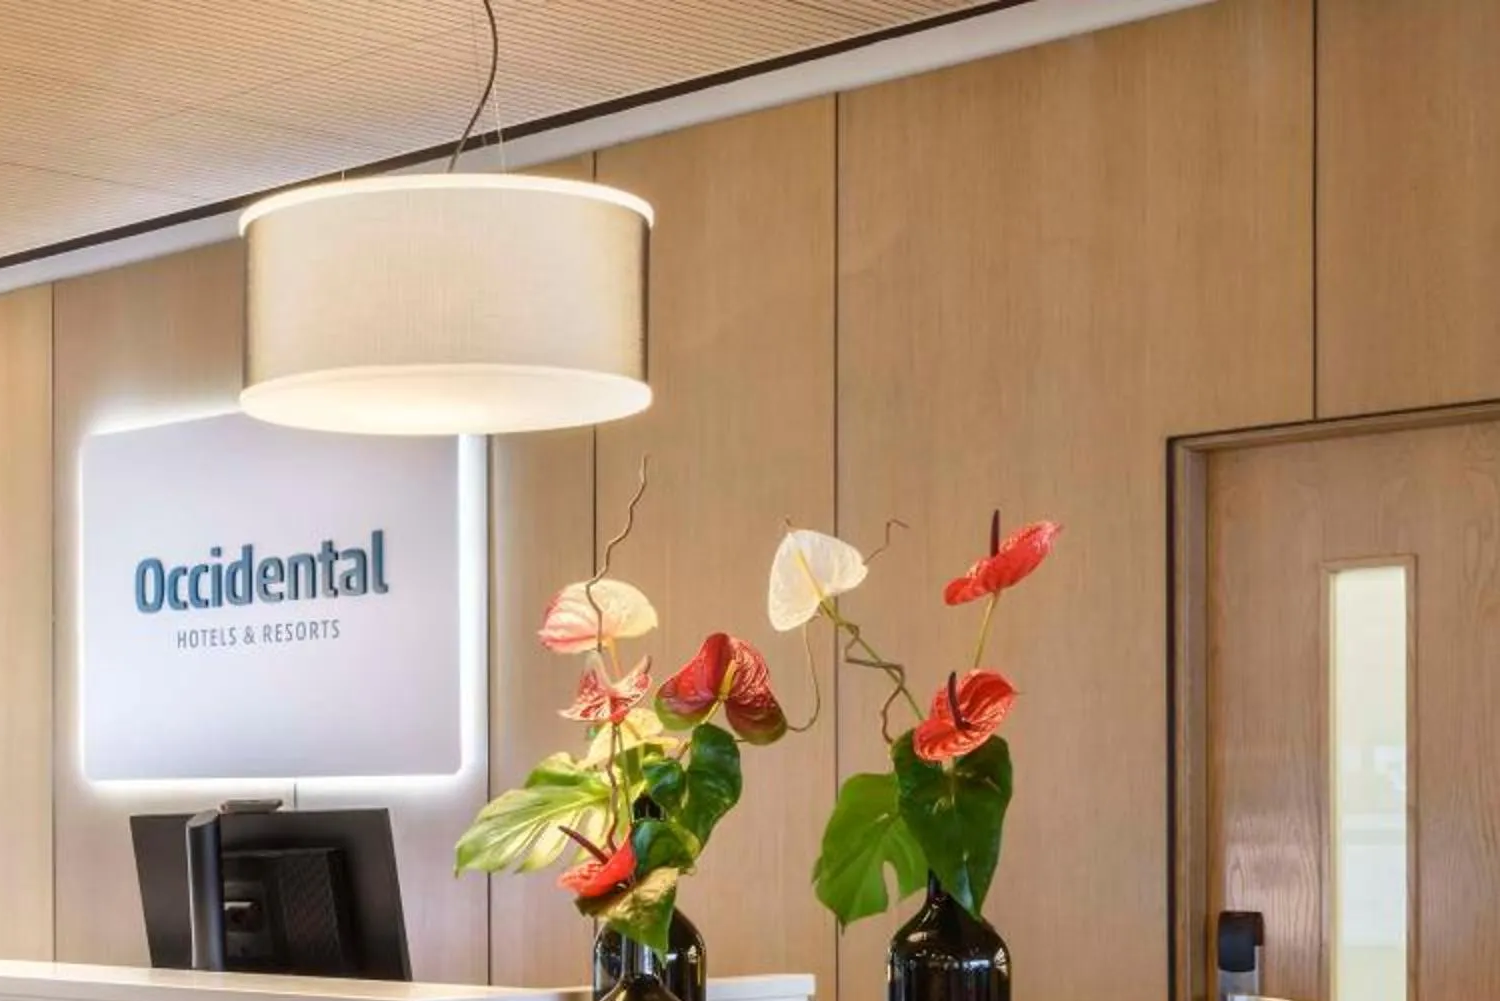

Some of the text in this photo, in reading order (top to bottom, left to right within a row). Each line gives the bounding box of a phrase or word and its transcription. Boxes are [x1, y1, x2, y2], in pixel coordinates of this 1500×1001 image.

[135, 530, 389, 613] Occidental
[177, 619, 340, 649] HOTELS & RESORTS
